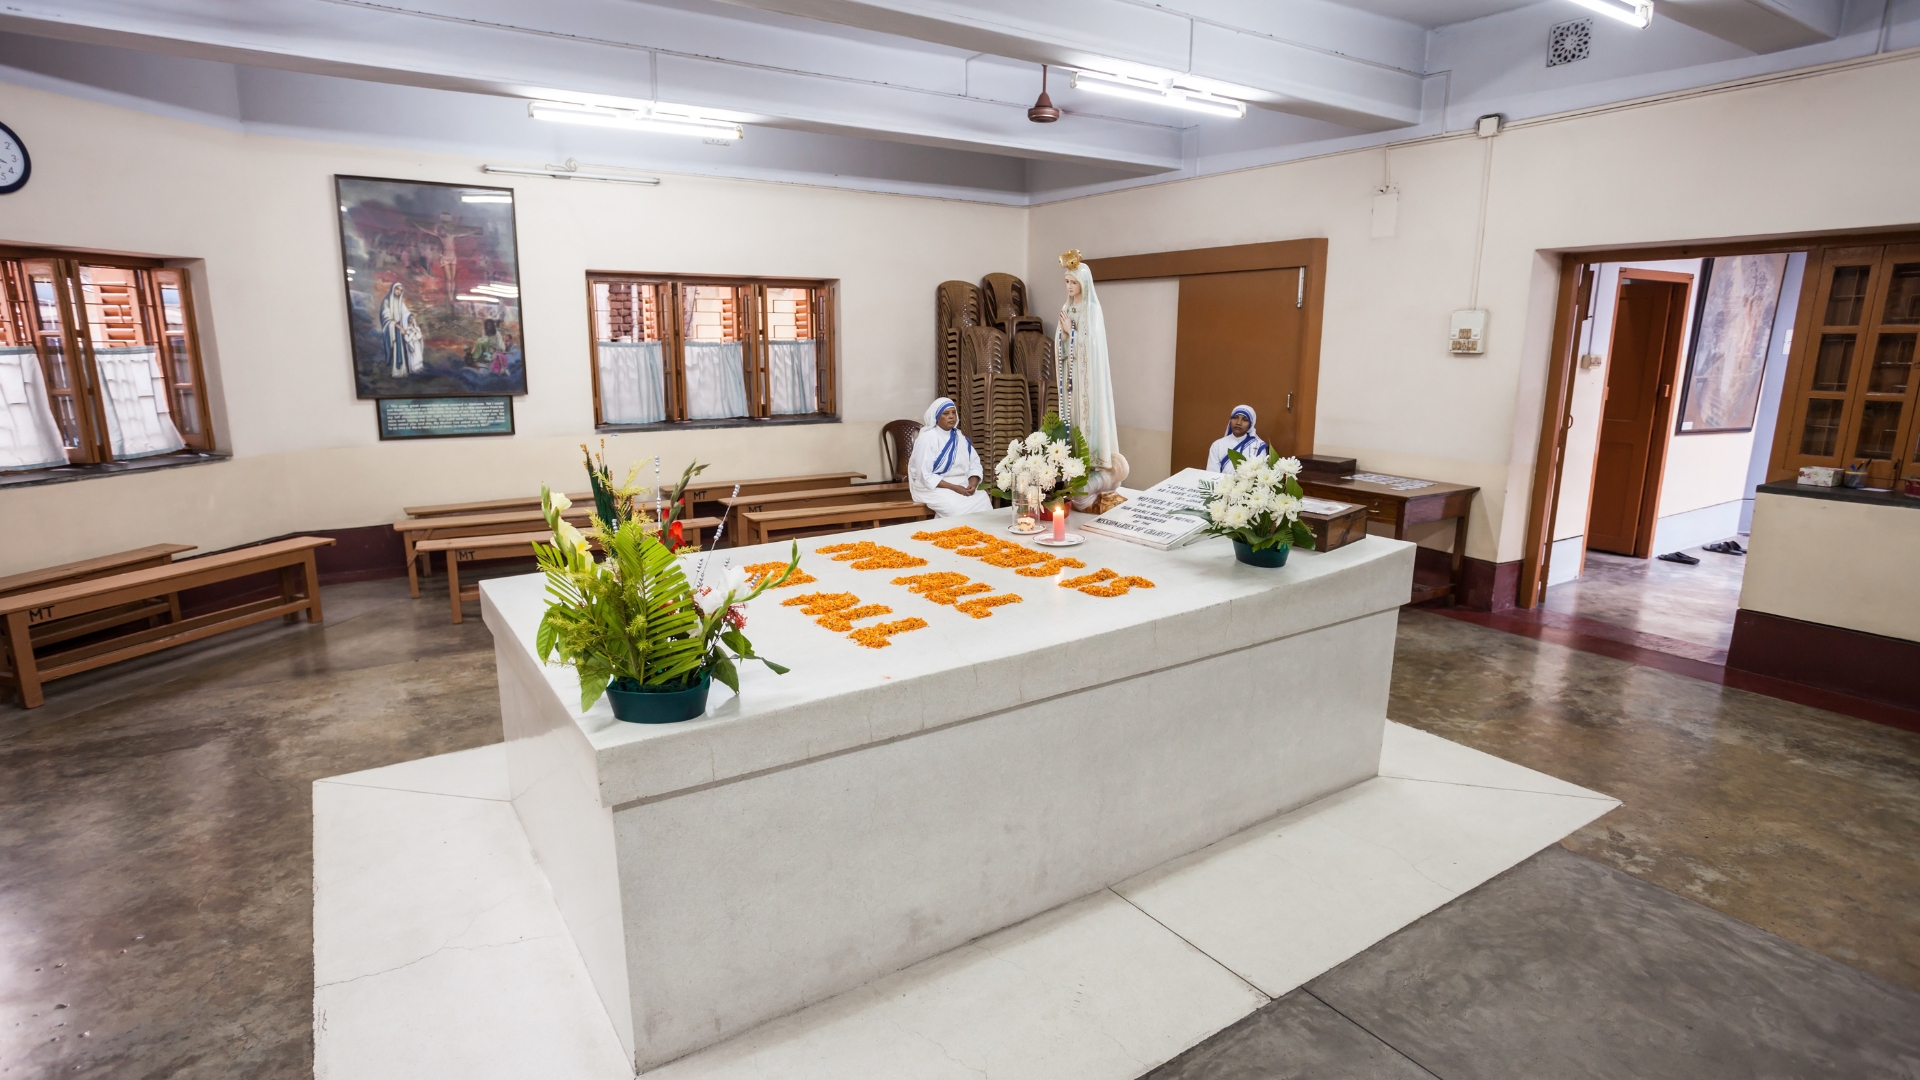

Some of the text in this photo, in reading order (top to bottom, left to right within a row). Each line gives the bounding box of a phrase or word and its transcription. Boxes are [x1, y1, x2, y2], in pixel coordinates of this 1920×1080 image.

[4, 141, 11, 150] 2
[11, 154, 17, 163] 3
[8, 166, 15, 174] 4
[1, 172, 7, 181] 5
[694, 490, 708, 500] MT
[1137, 496, 1167, 506] MOTHER
[748, 505, 764, 513] MT
[1132, 513, 1168, 524] FOUNDRESS
[1150, 511, 1174, 520] BELOVED
[1174, 516, 1197, 524] MOTHER
[1094, 517, 1137, 530] MISSIONARIES
[1143, 528, 1176, 539] CHARITY
[459, 551, 475, 560] MT
[29, 605, 55, 622] MT
